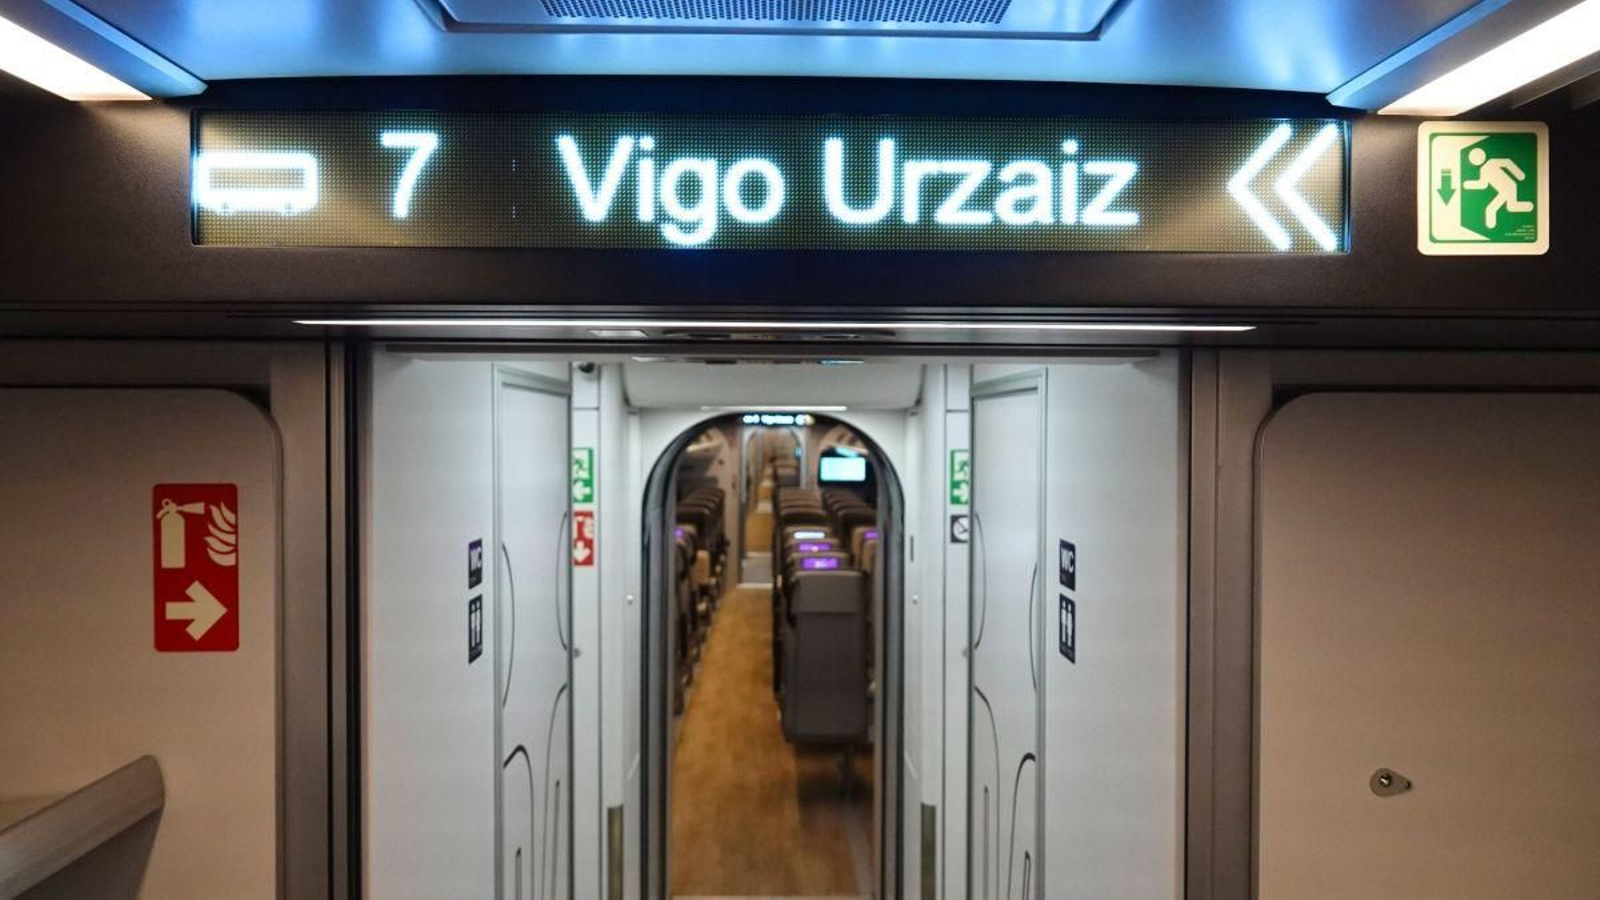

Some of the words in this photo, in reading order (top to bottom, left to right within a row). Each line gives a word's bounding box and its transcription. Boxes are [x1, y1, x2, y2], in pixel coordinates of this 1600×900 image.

[379, 131, 439, 220] 7
[557, 134, 786, 247] Vigo
[823, 136, 1140, 228] Urzaiz
[470, 546, 482, 572] WC
[1060, 547, 1074, 573] WC
